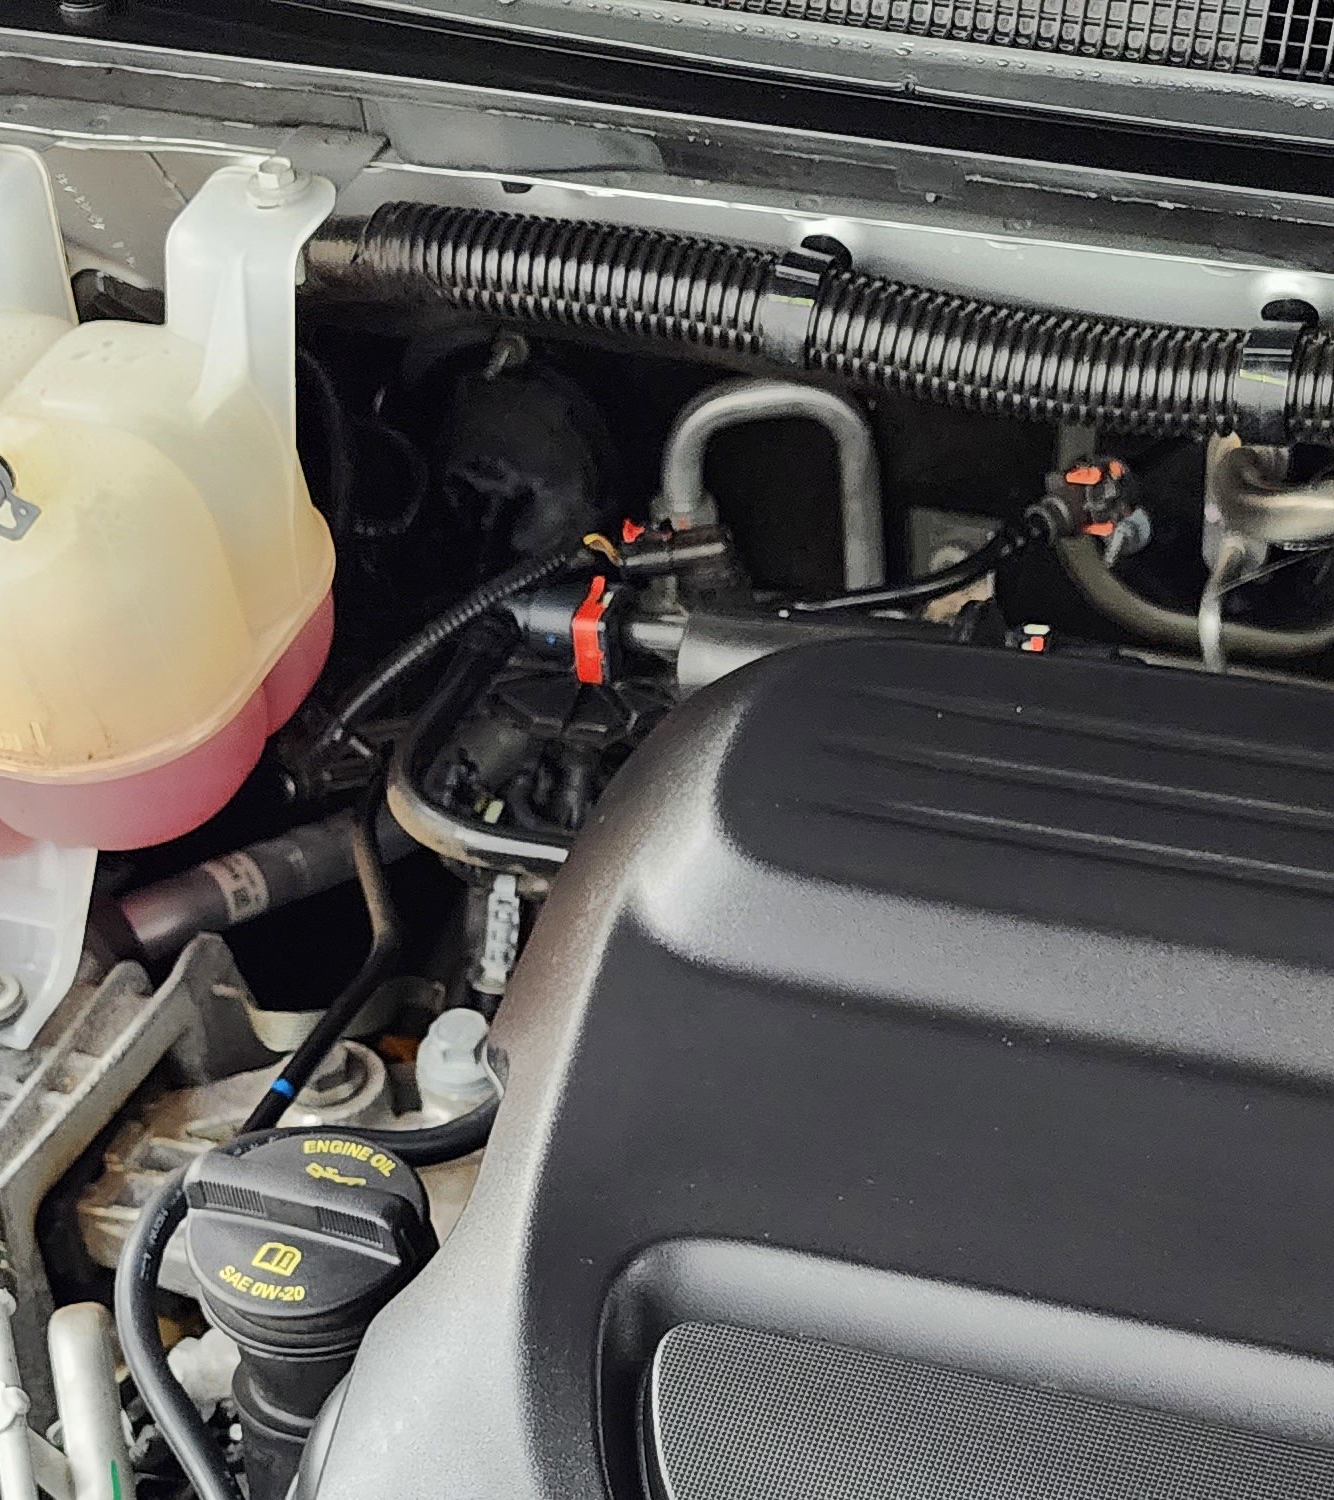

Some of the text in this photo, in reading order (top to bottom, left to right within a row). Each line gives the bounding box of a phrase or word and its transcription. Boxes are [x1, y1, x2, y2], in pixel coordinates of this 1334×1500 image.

[303, 1140, 398, 1177] ENGINE OIL
[219, 1265, 306, 1302] SAE 0W-20
